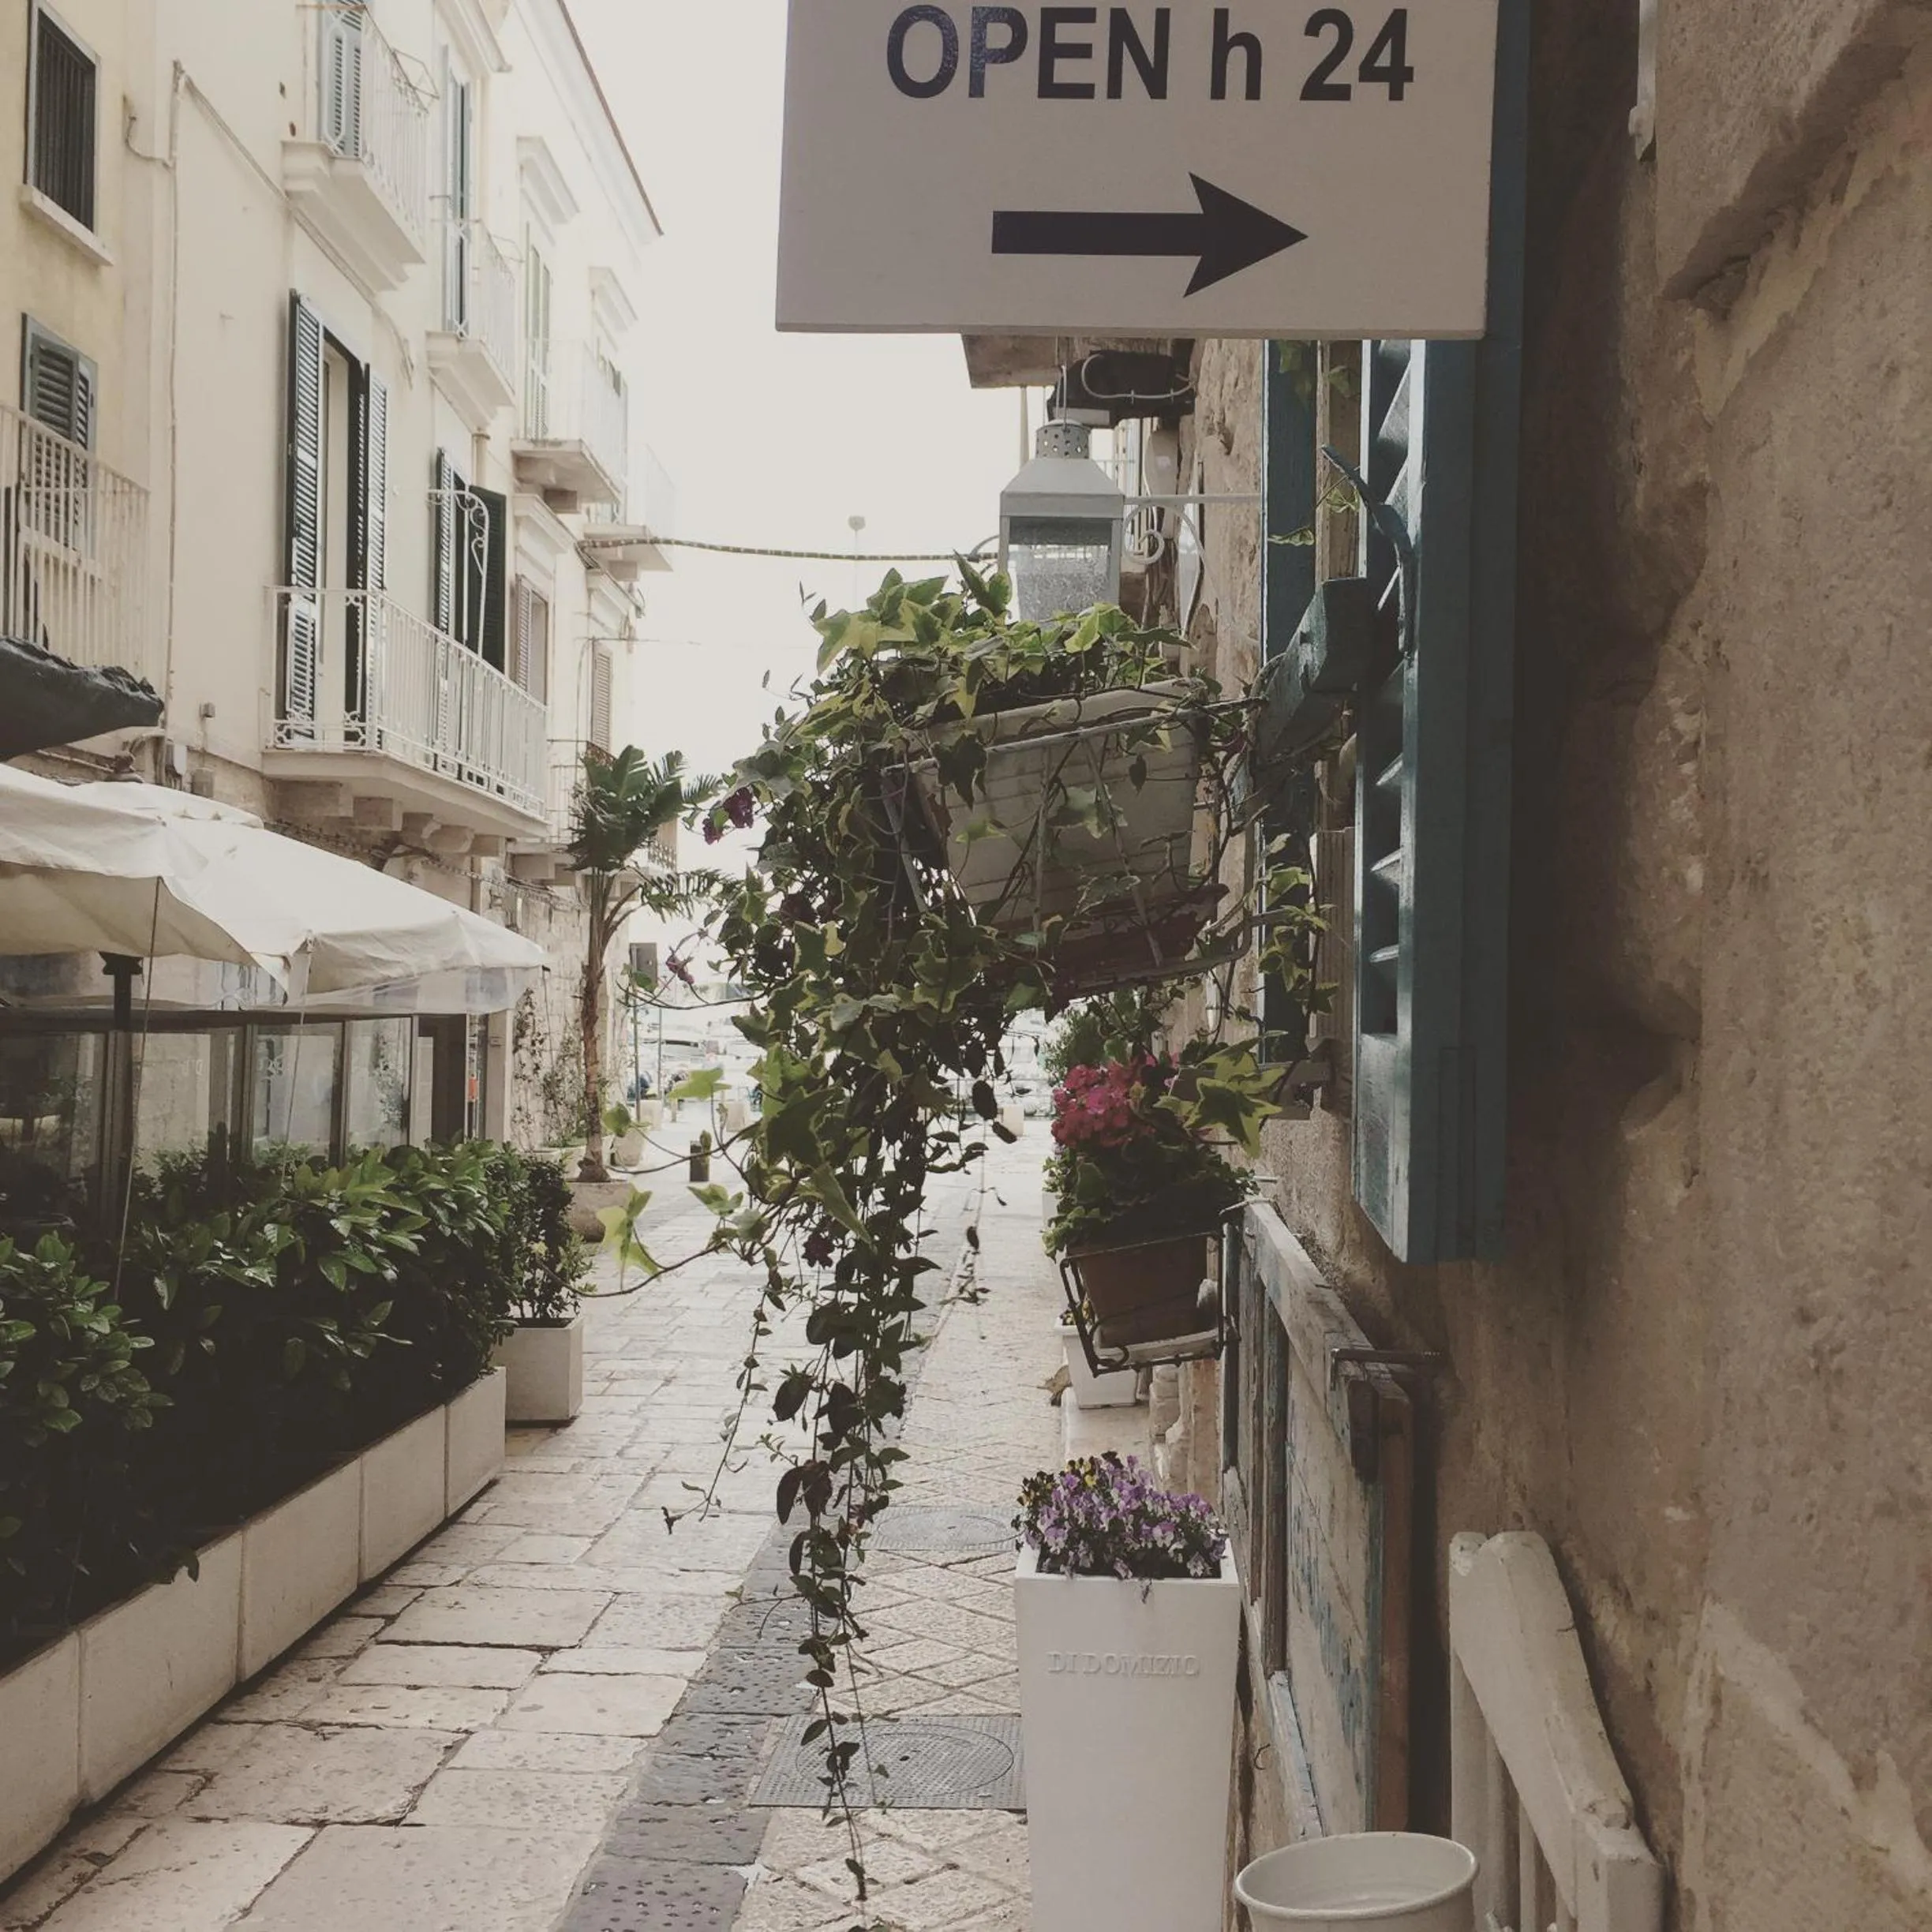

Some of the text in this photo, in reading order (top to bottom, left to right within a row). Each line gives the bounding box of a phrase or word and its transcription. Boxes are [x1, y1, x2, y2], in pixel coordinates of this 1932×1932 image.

[887, 4, 1414, 102] OPEN h 24
